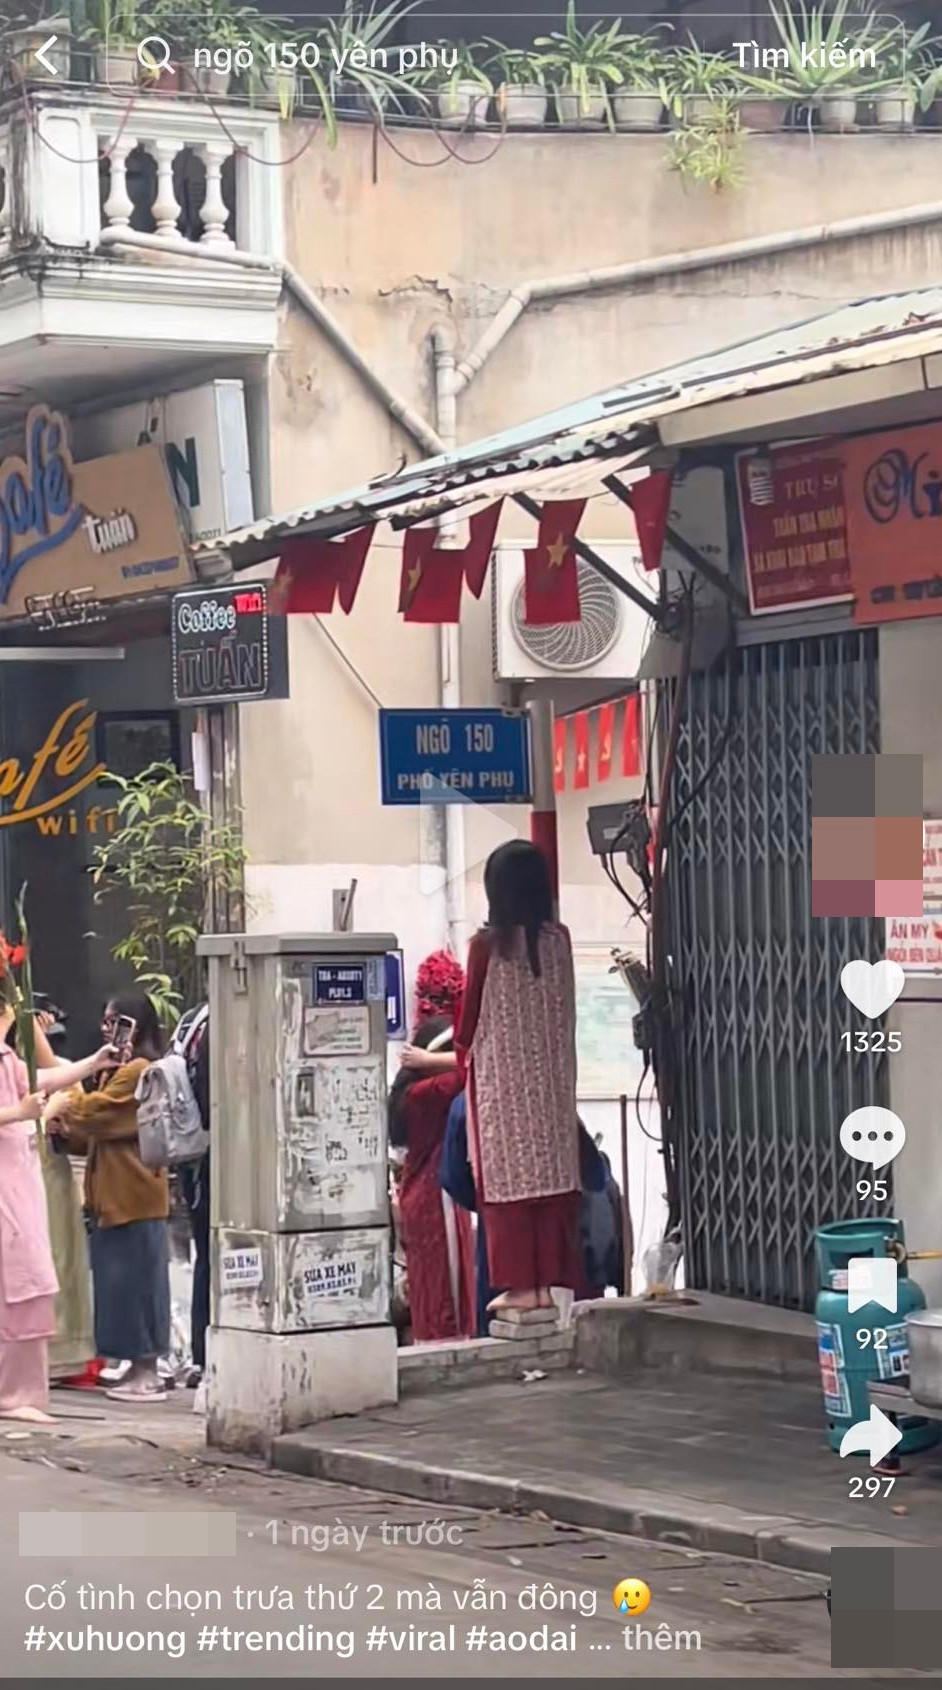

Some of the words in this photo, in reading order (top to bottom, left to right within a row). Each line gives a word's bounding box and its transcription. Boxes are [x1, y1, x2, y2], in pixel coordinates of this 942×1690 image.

[178, 600, 236, 634] Coffee
[416, 717, 451, 754] NGÕ
[465, 723, 494, 753] 150
[397, 766, 434, 790] PHỐ
[440, 767, 474, 789] YÊN
